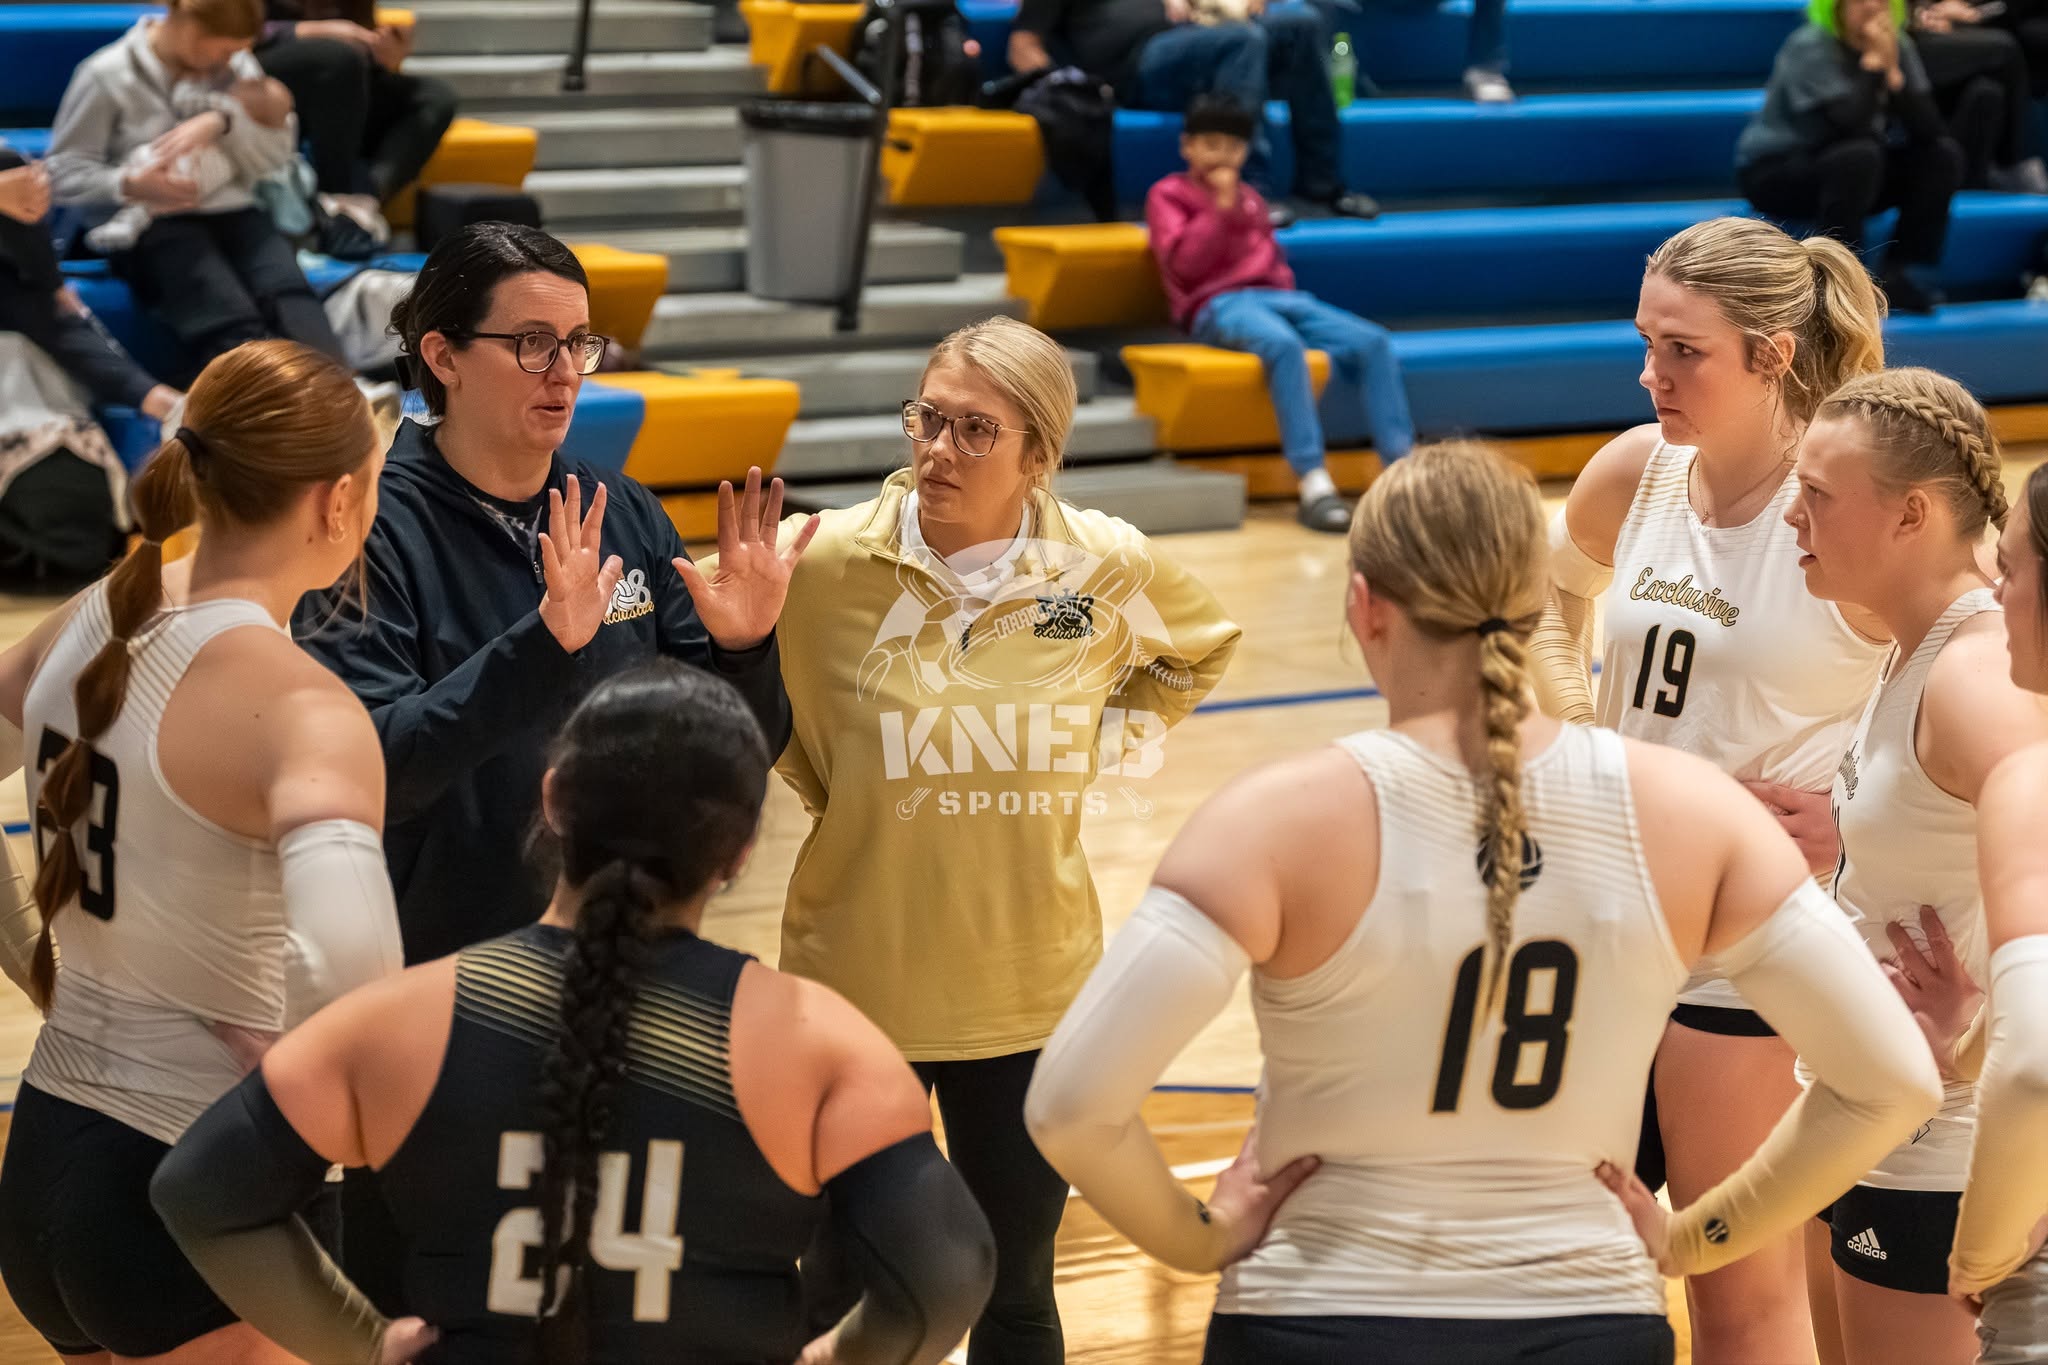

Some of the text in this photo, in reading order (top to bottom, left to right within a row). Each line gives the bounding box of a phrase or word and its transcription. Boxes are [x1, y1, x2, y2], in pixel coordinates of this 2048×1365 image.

[1033, 625, 1096, 640] exclusive
[1630, 566, 1740, 627] Exclusive
[1632, 623, 1696, 719] 19
[1429, 939, 1581, 1115] 18
[487, 1131, 685, 1323] 24
[1847, 1239, 1887, 1261] adidas
